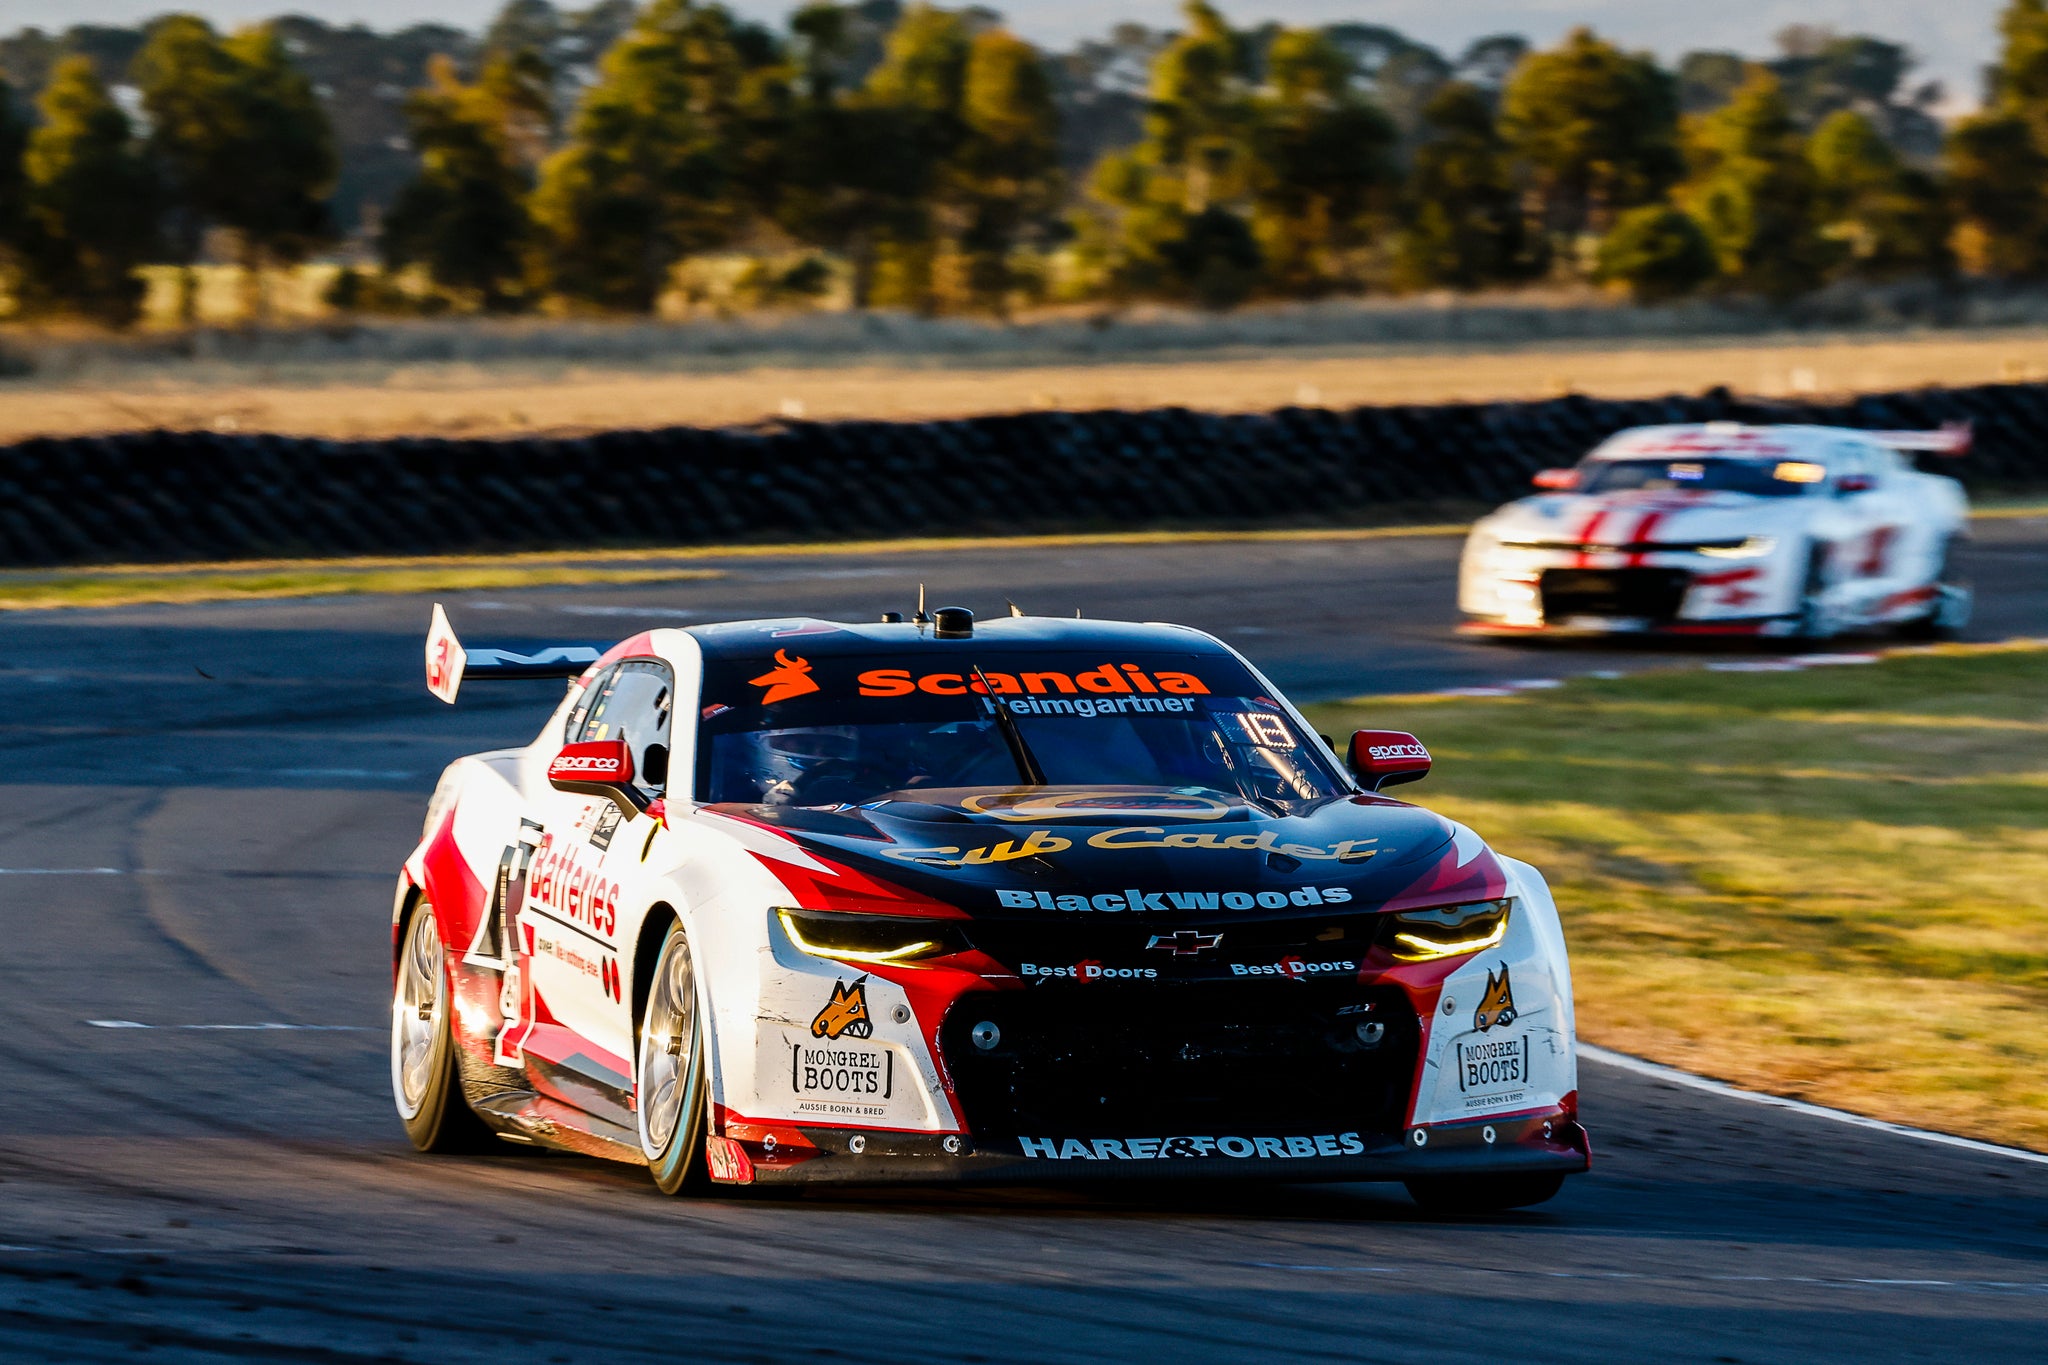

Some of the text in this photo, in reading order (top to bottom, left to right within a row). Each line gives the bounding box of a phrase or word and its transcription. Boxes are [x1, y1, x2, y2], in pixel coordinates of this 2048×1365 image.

[858, 663, 1211, 697] Scandia
[1368, 743, 1426, 759] sparco
[553, 756, 619, 771] sparco
[880, 826, 1379, 866] Cub Cadet
[531, 832, 619, 937] Batteries
[996, 885, 1353, 912] Blackwoods
[1021, 963, 1158, 978] Best Doors
[1231, 957, 1355, 976] Best Doors
[804, 1049, 880, 1068] MONGREL
[1465, 1041, 1520, 1061] MONGREL
[804, 1066, 879, 1094] BOOTS
[1468, 1058, 1520, 1087] BOOTS
[799, 1103, 884, 1116] AUSSIE BORN & BRED
